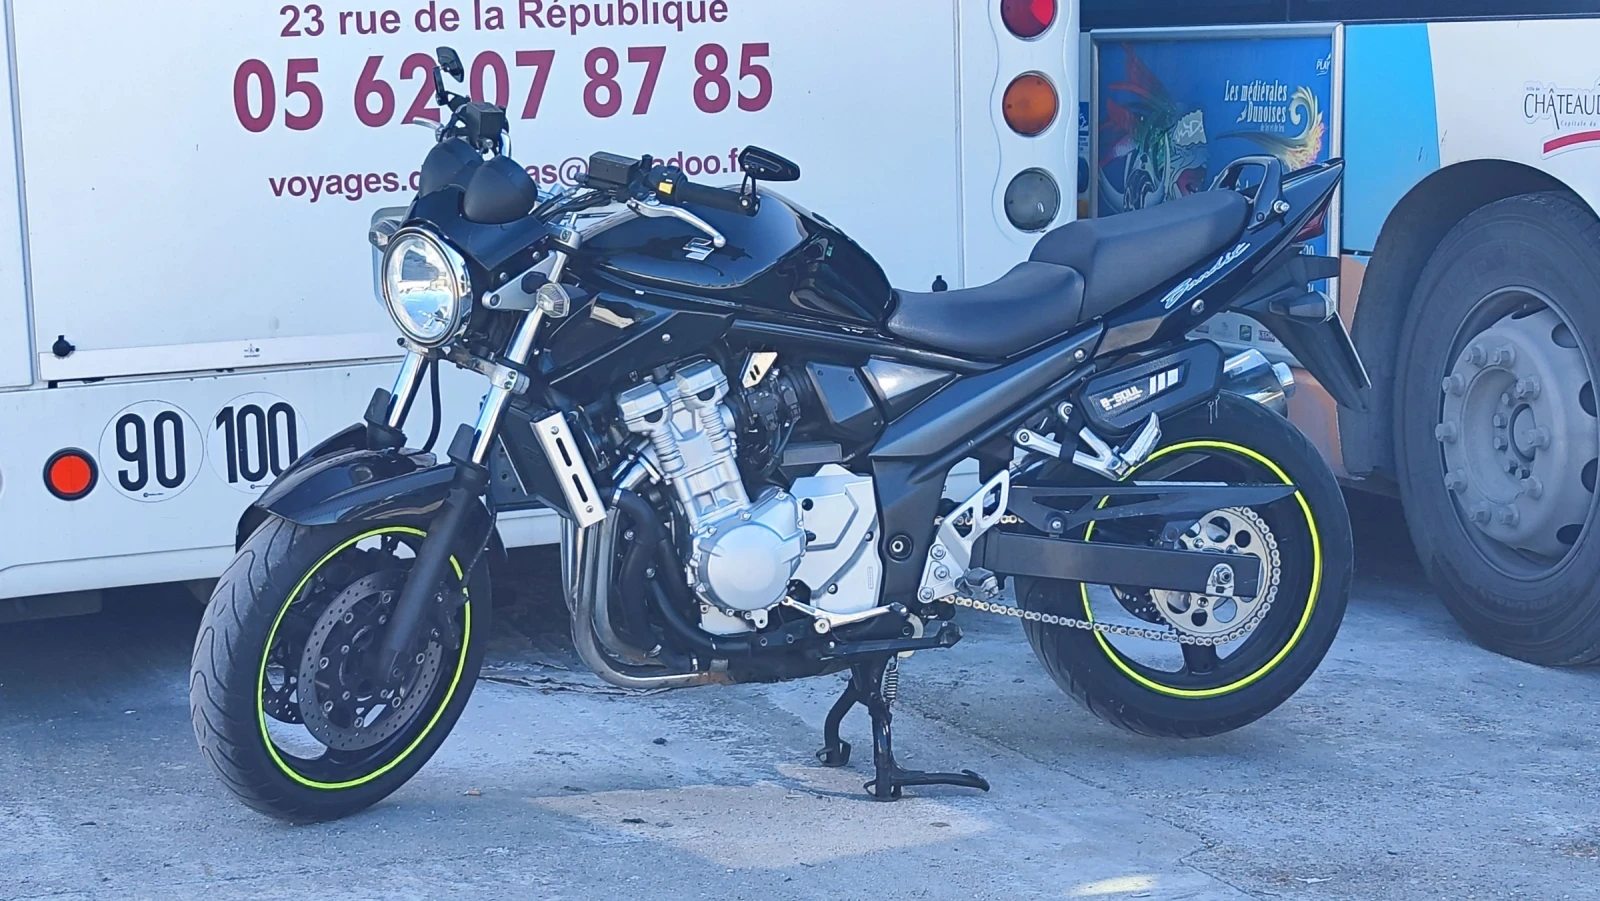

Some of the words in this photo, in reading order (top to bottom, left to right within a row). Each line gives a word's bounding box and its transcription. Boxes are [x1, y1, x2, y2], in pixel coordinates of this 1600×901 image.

[279, 4, 326, 38] 23
[338, 9, 401, 35] rue
[414, 0, 460, 33] de
[473, 0, 505, 31] la
[518, 0, 729, 36] République
[233, 57, 324, 133] 05
[354, 52, 441, 128] 62
[469, 49, 556, 120] 07
[583, 46, 667, 119] 87
[693, 42, 773, 114] 85
[1224, 80, 1239, 102] Les
[1240, 79, 1288, 102] médiévales
[1246, 102, 1287, 123] Dunoises
[115, 410, 187, 492] 90
[215, 401, 299, 484] 100
